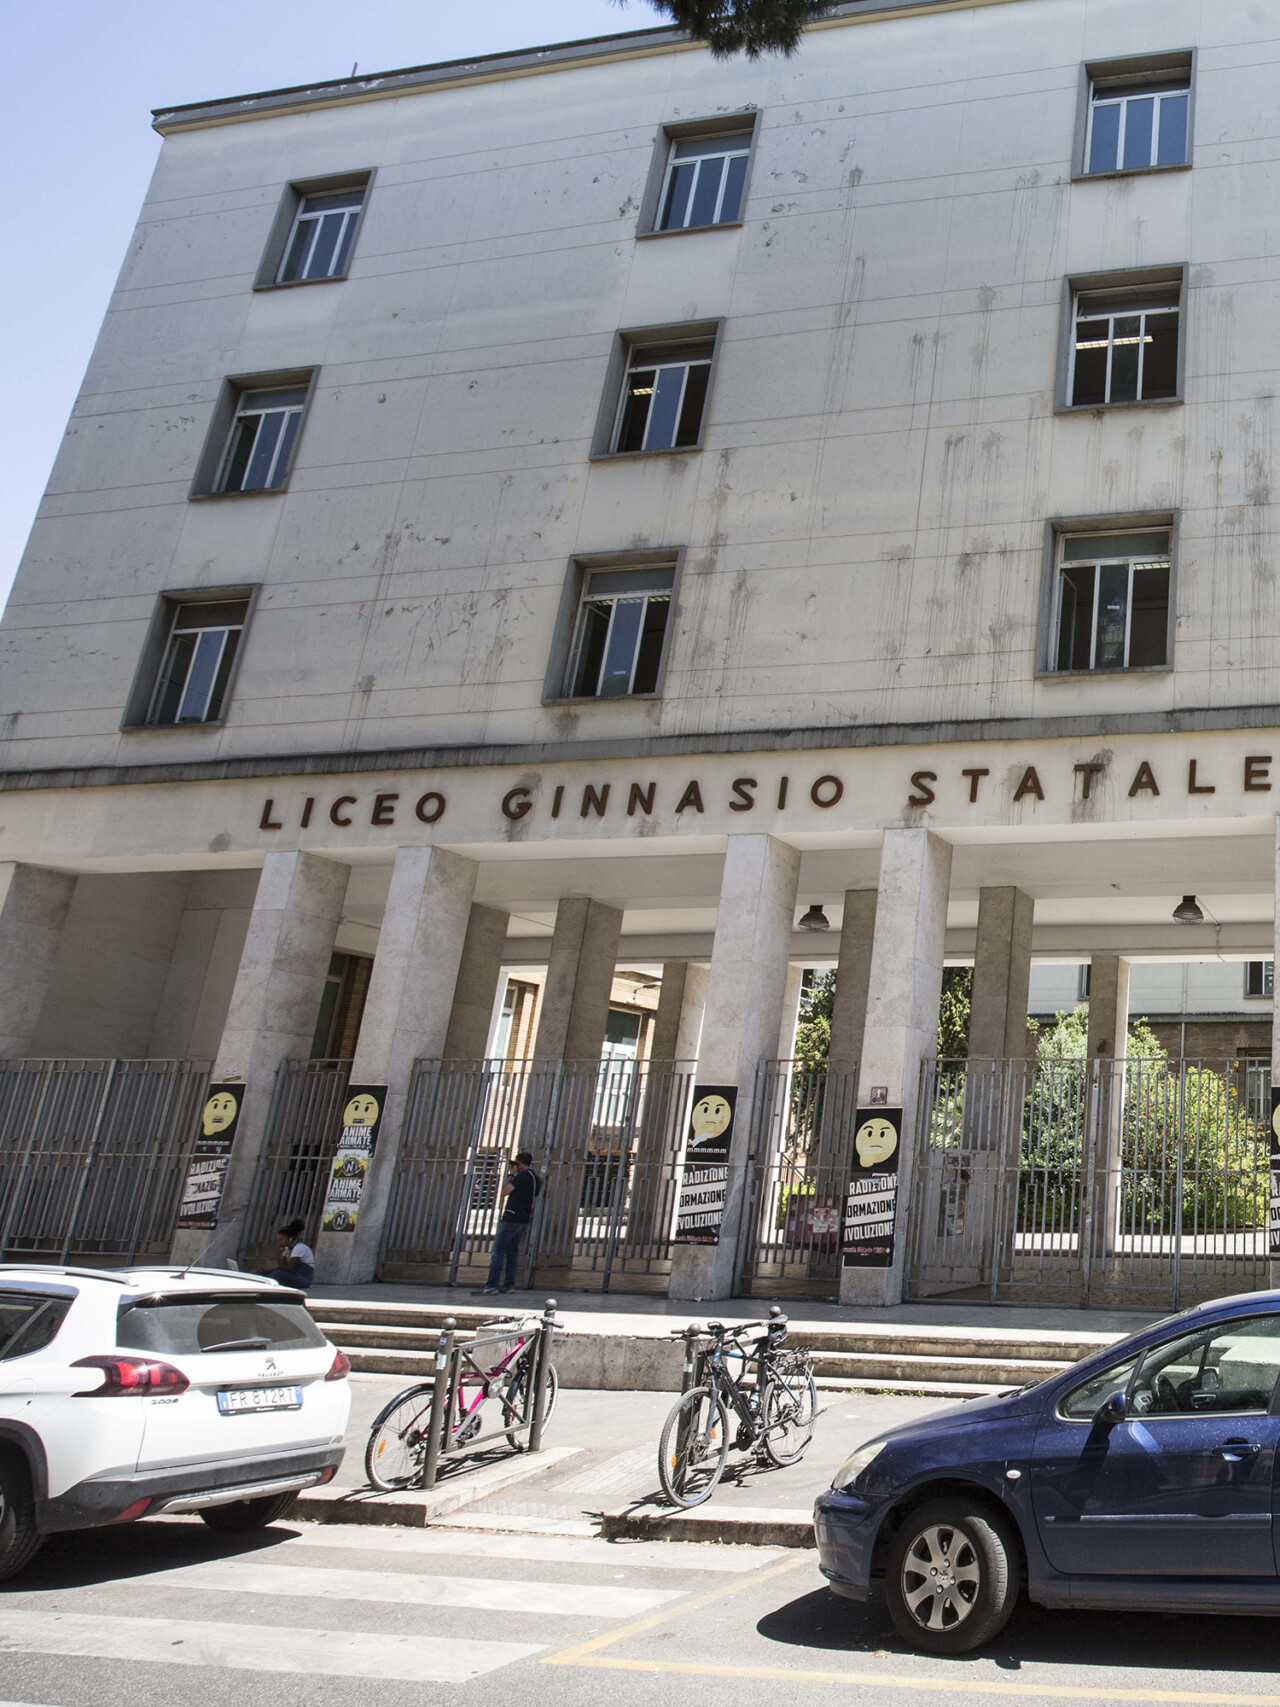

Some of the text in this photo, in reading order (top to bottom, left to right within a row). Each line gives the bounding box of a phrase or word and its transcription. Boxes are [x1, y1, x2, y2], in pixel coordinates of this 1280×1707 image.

[259, 792, 447, 830] LICEO
[501, 774, 844, 819] GINNASIO
[908, 755, 1273, 808] STATALE
[343, 1126, 372, 1137] ANIME
[340, 1136, 372, 1145] ARMATE
[682, 1166, 729, 1185] RADIZIONE
[332, 1179, 362, 1189] ANIME
[329, 1188, 362, 1198] ARMATE
[680, 1190, 726, 1207] ORMAZIONE
[847, 1199, 896, 1218] ORMAZIONE
